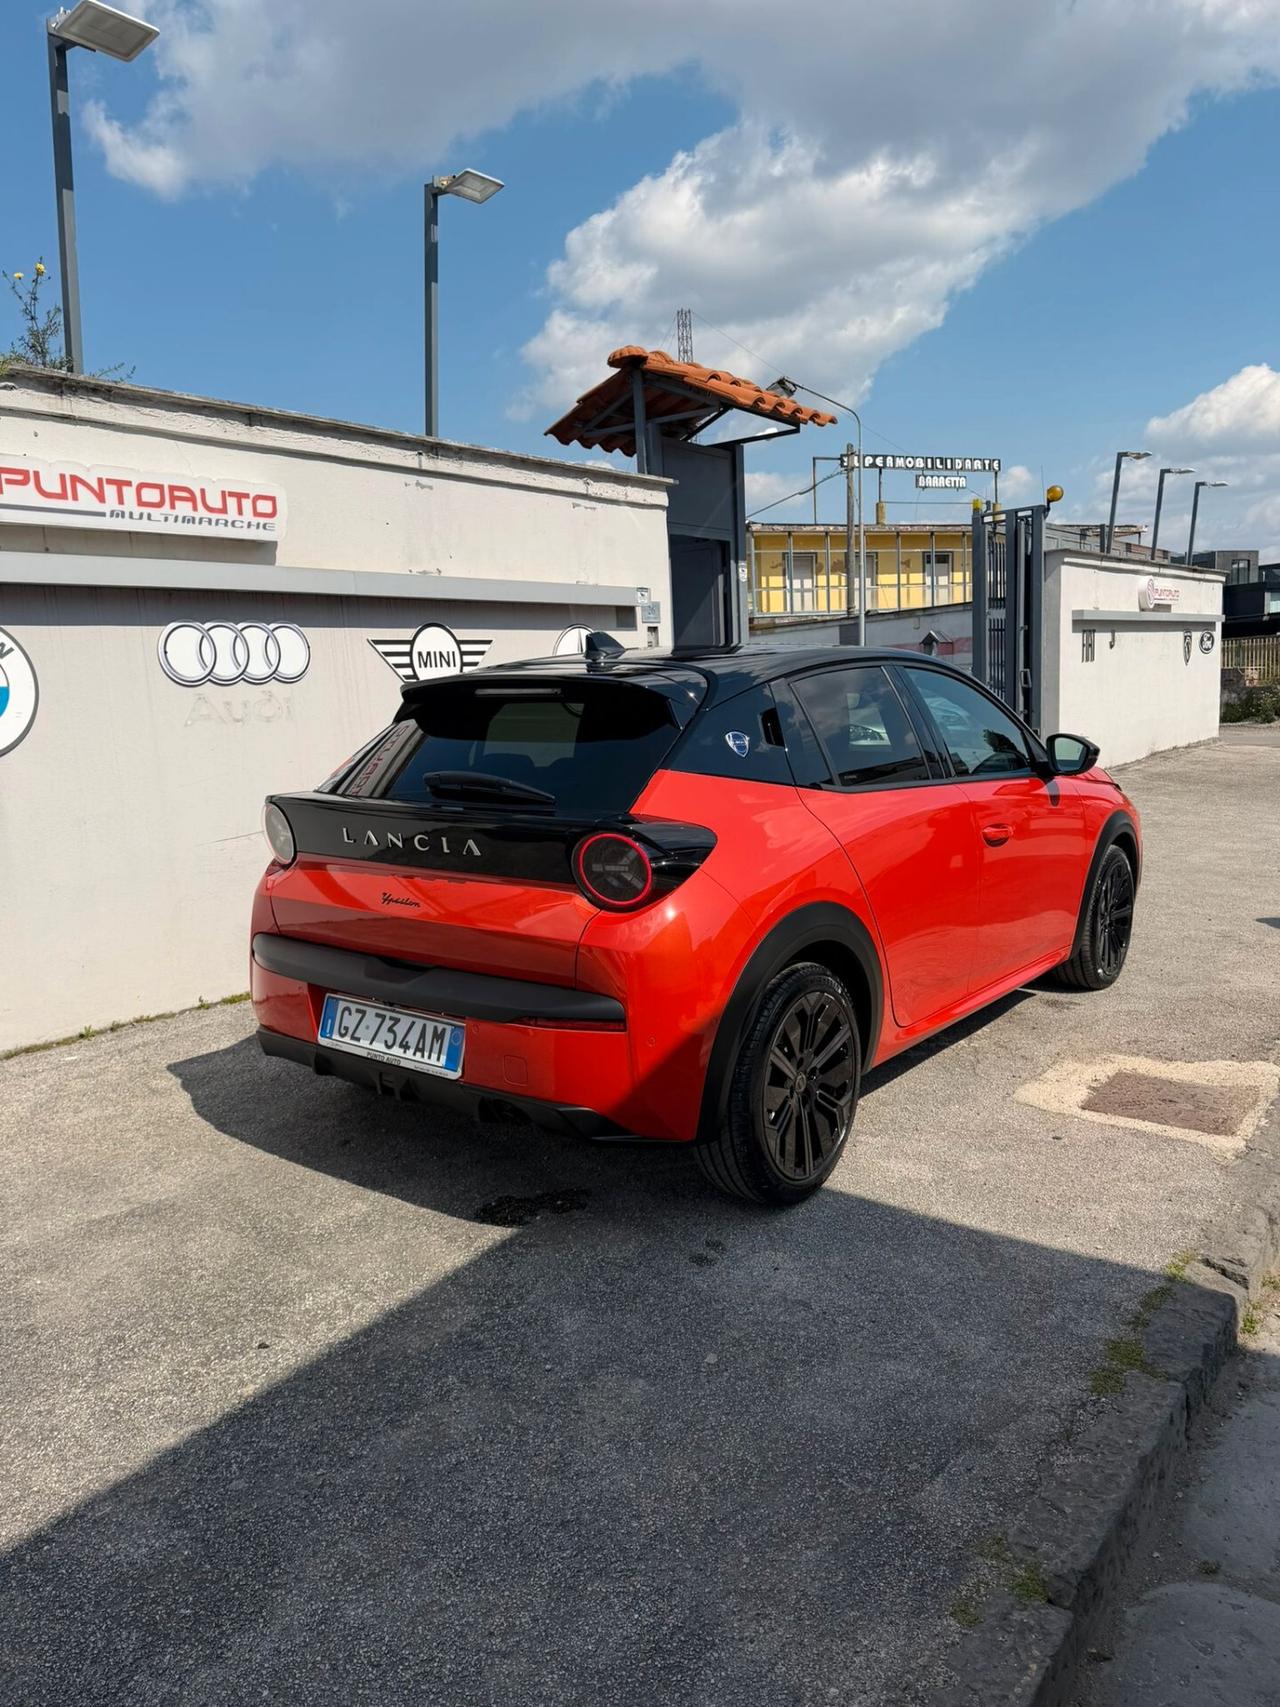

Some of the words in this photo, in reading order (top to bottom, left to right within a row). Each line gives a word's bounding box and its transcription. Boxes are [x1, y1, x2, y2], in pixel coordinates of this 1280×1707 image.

[918, 475, 966, 488] BARRETTA
[0, 466, 278, 519] PUNTOAUTO
[109, 508, 276, 532] MULTIMARCHE
[417, 650, 457, 669] MINI
[342, 827, 482, 857] LANCIA
[366, 1051, 385, 1062] PUNTO
[386, 1056, 402, 1066] AUTO
